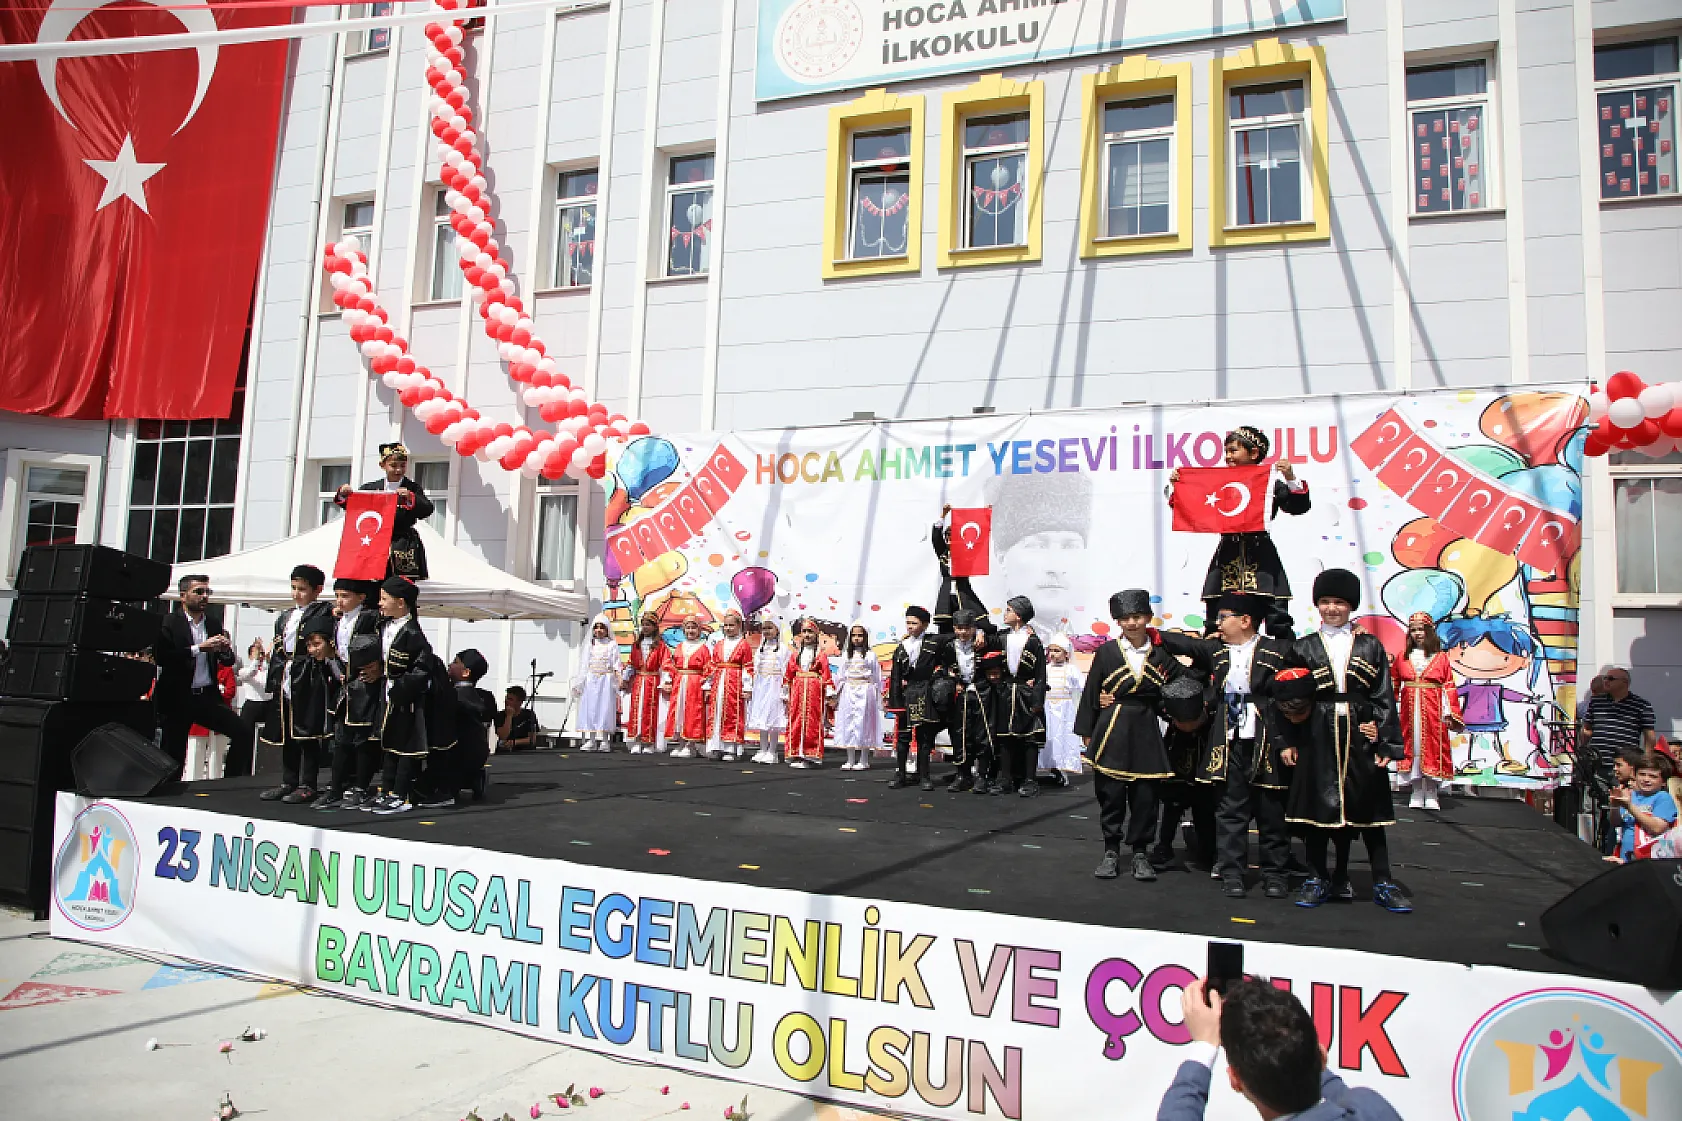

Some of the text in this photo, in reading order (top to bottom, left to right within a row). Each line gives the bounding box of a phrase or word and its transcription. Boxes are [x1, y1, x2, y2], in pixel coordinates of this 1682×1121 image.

[882, 0, 967, 31] HOCA
[882, 21, 1039, 64] İLKOKULU
[755, 424, 1338, 486] HOCA AHMET YESEVİ İLKOULU
[154, 826, 201, 883] 23
[209, 822, 340, 908] NİSAN
[352, 855, 544, 945] ULUSAL
[558, 885, 939, 1010] EGEMENLİK
[953, 938, 1062, 1028] VE
[315, 923, 1023, 1120] BAYRAMI KUTLU OLSUN
